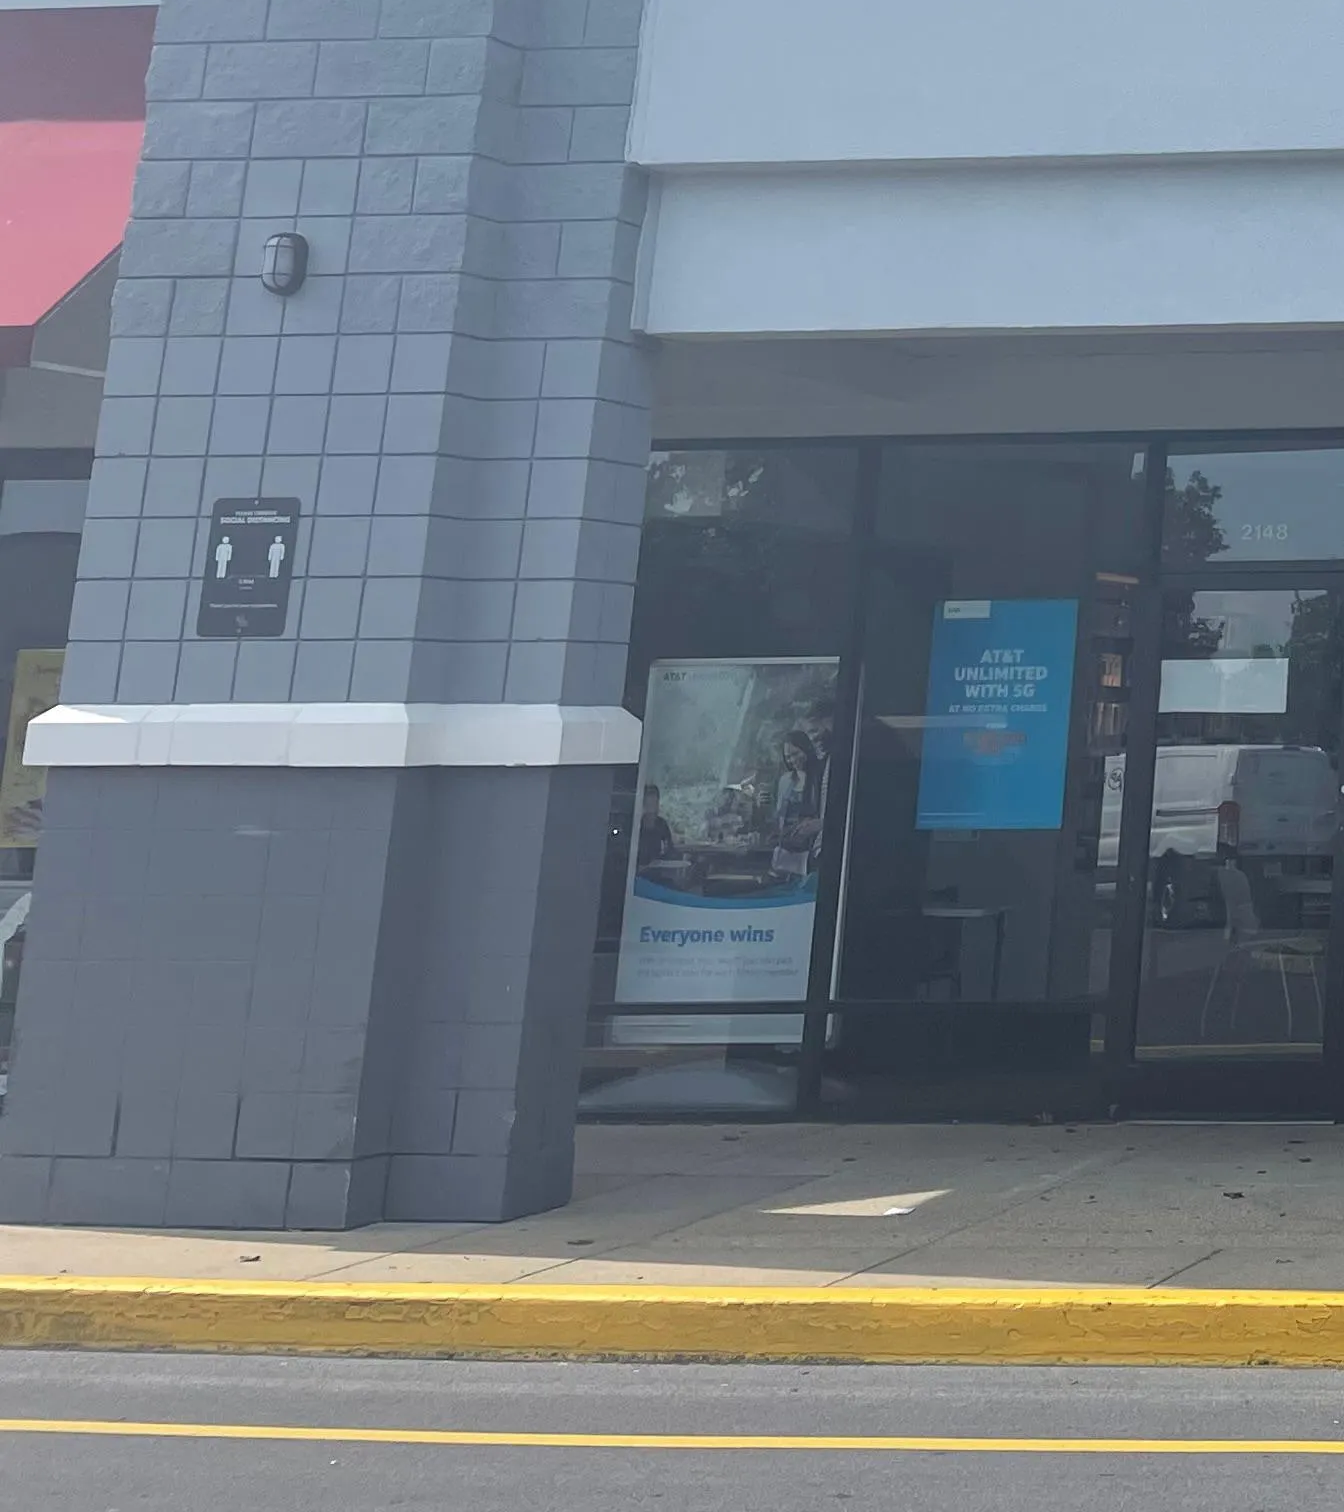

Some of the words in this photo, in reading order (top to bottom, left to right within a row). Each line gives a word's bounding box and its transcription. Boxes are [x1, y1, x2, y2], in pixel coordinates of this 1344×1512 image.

[1241, 524, 1288, 540] 2148
[980, 649, 1024, 663] AT&T
[954, 666, 1048, 681] UNLIMITED
[965, 684, 1008, 698] WITH
[1013, 684, 1036, 698] 5G
[640, 926, 724, 948] Everyone
[730, 925, 775, 943] wins
